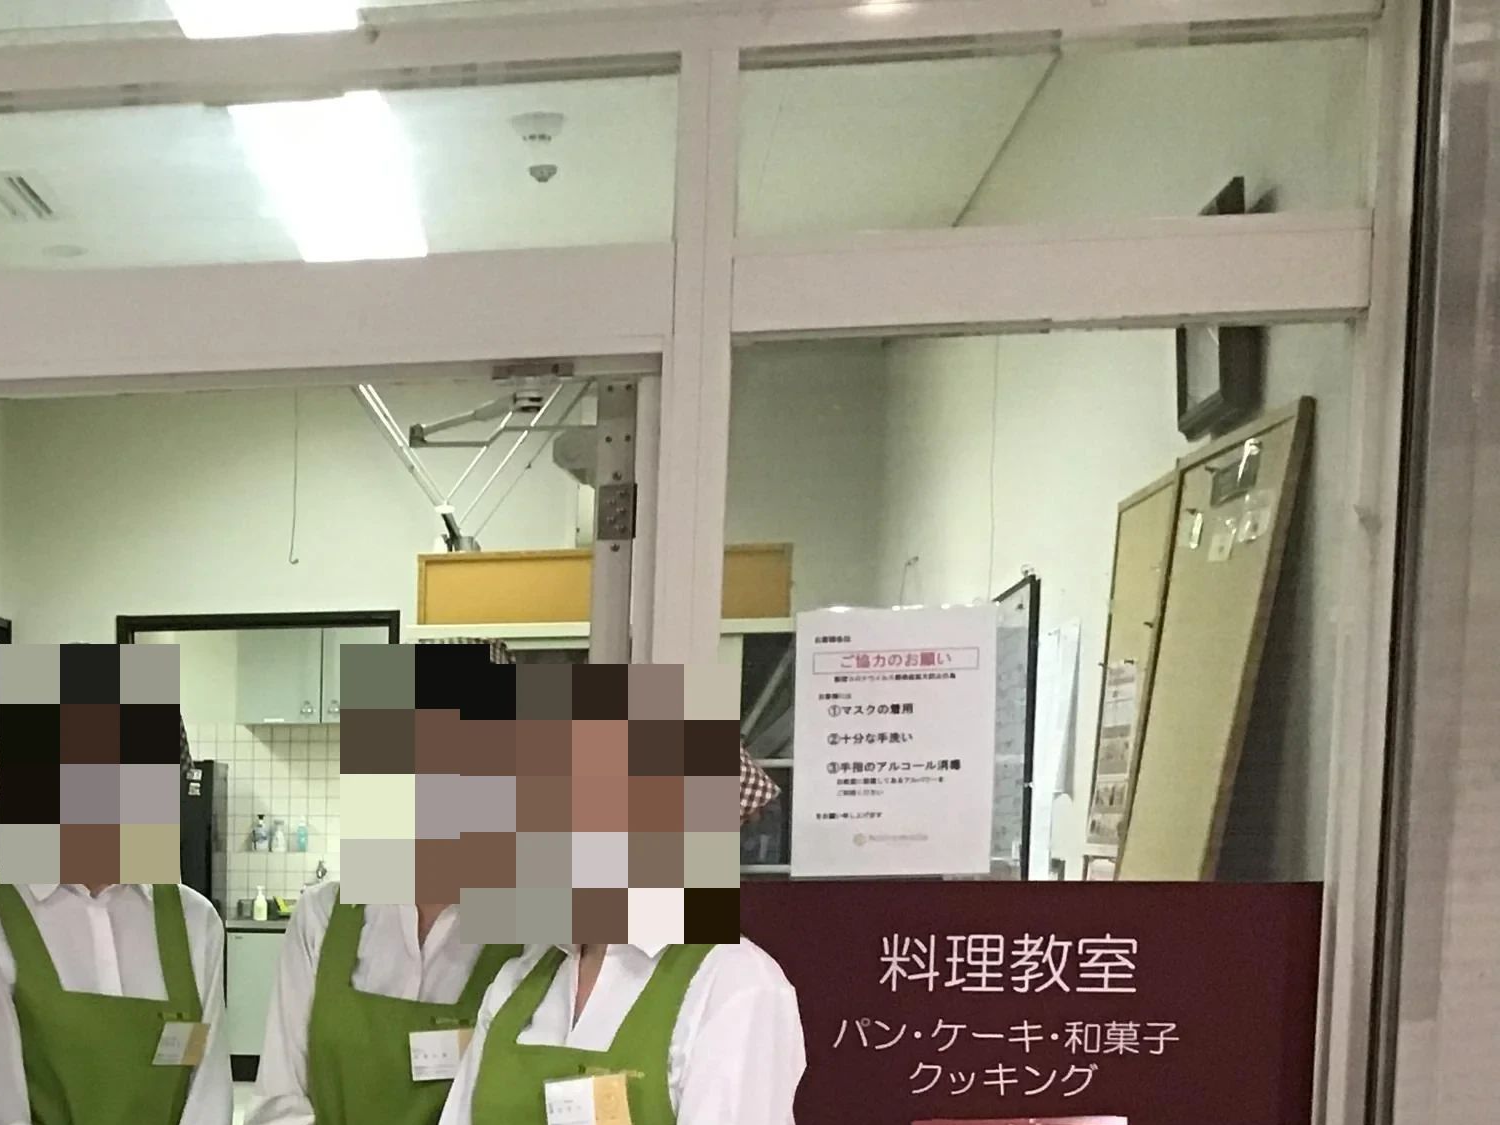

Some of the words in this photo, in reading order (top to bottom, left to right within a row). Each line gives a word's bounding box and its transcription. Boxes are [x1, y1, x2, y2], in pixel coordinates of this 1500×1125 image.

[840, 651, 952, 668] ご協力のお願い
[879, 932, 1138, 994] 料理教室
[833, 1018, 1180, 1056] パン・ケーキ・和菓子
[908, 1062, 1098, 1097] クッキング
